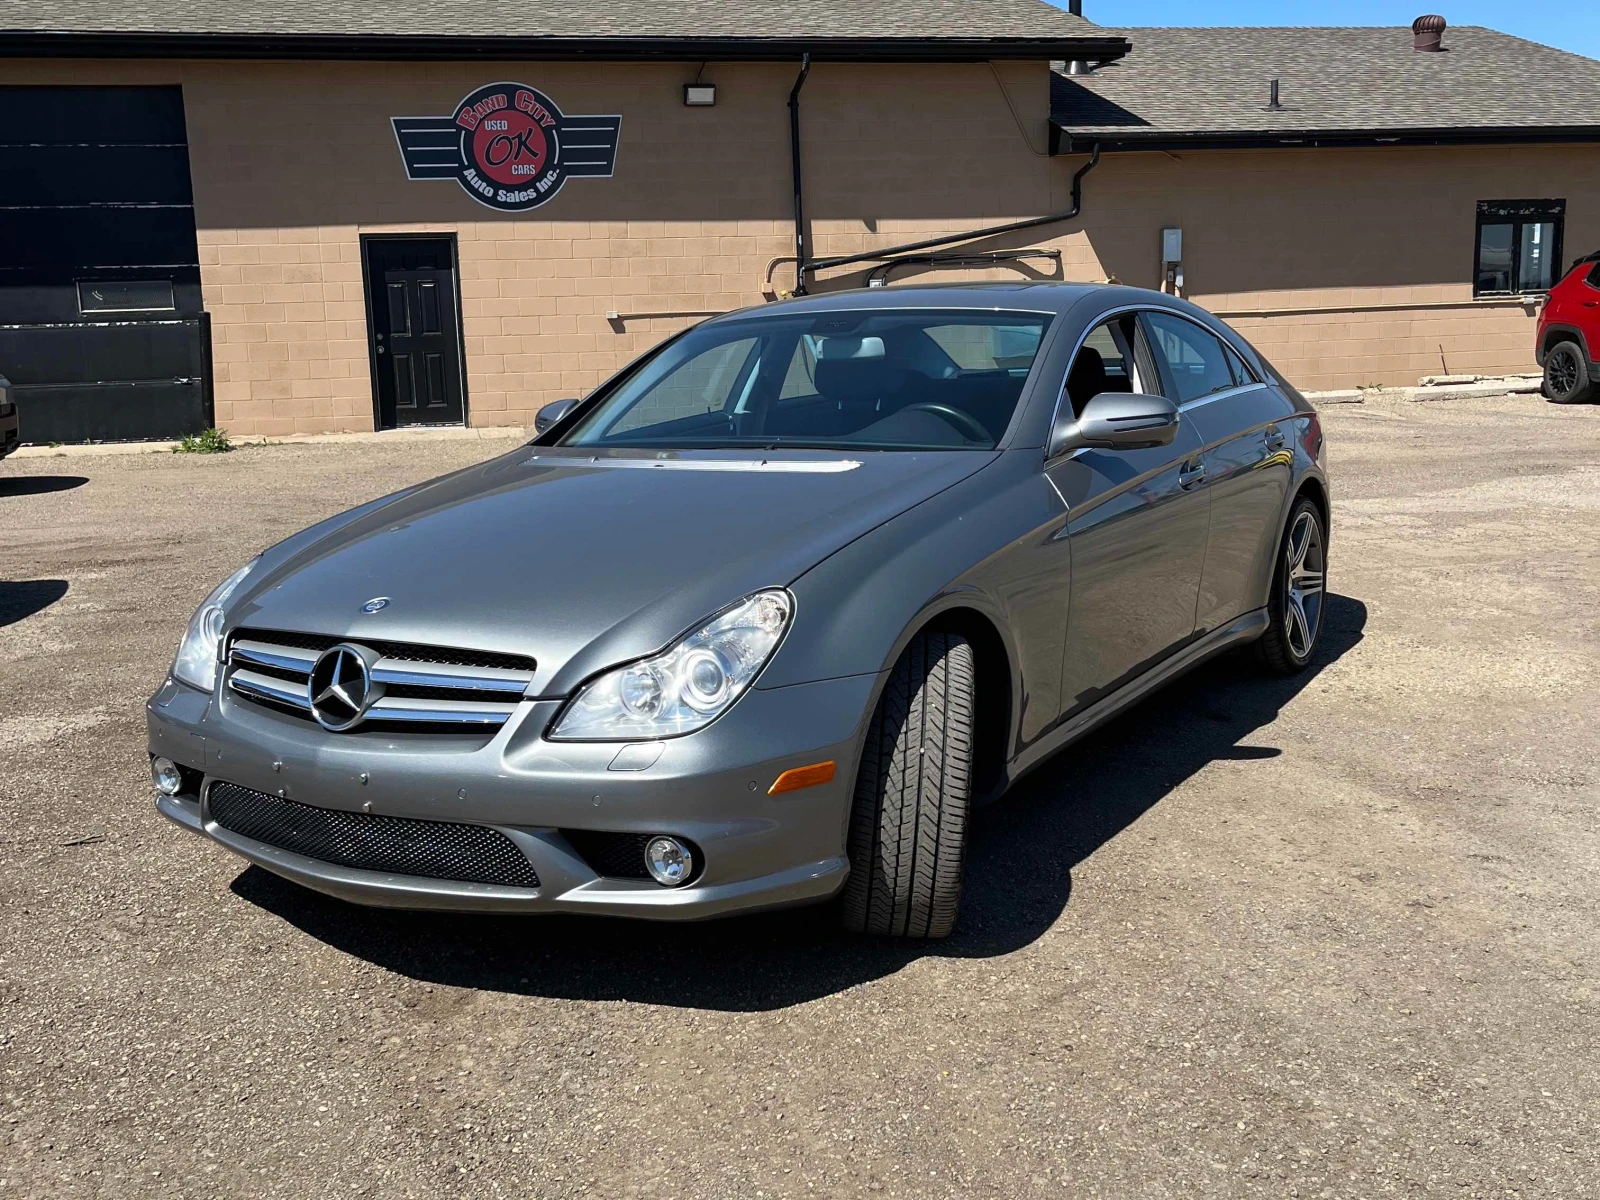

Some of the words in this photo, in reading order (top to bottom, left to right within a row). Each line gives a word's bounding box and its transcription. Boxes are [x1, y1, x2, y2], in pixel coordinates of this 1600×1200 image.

[456, 94, 508, 131] BAND
[515, 89, 556, 127] CITY
[485, 120, 508, 131] USED
[484, 127, 540, 167] OK
[463, 168, 494, 197] Auto
[497, 188, 537, 202] Sales
[536, 168, 560, 193] Inc.
[512, 164, 535, 175] CARS
